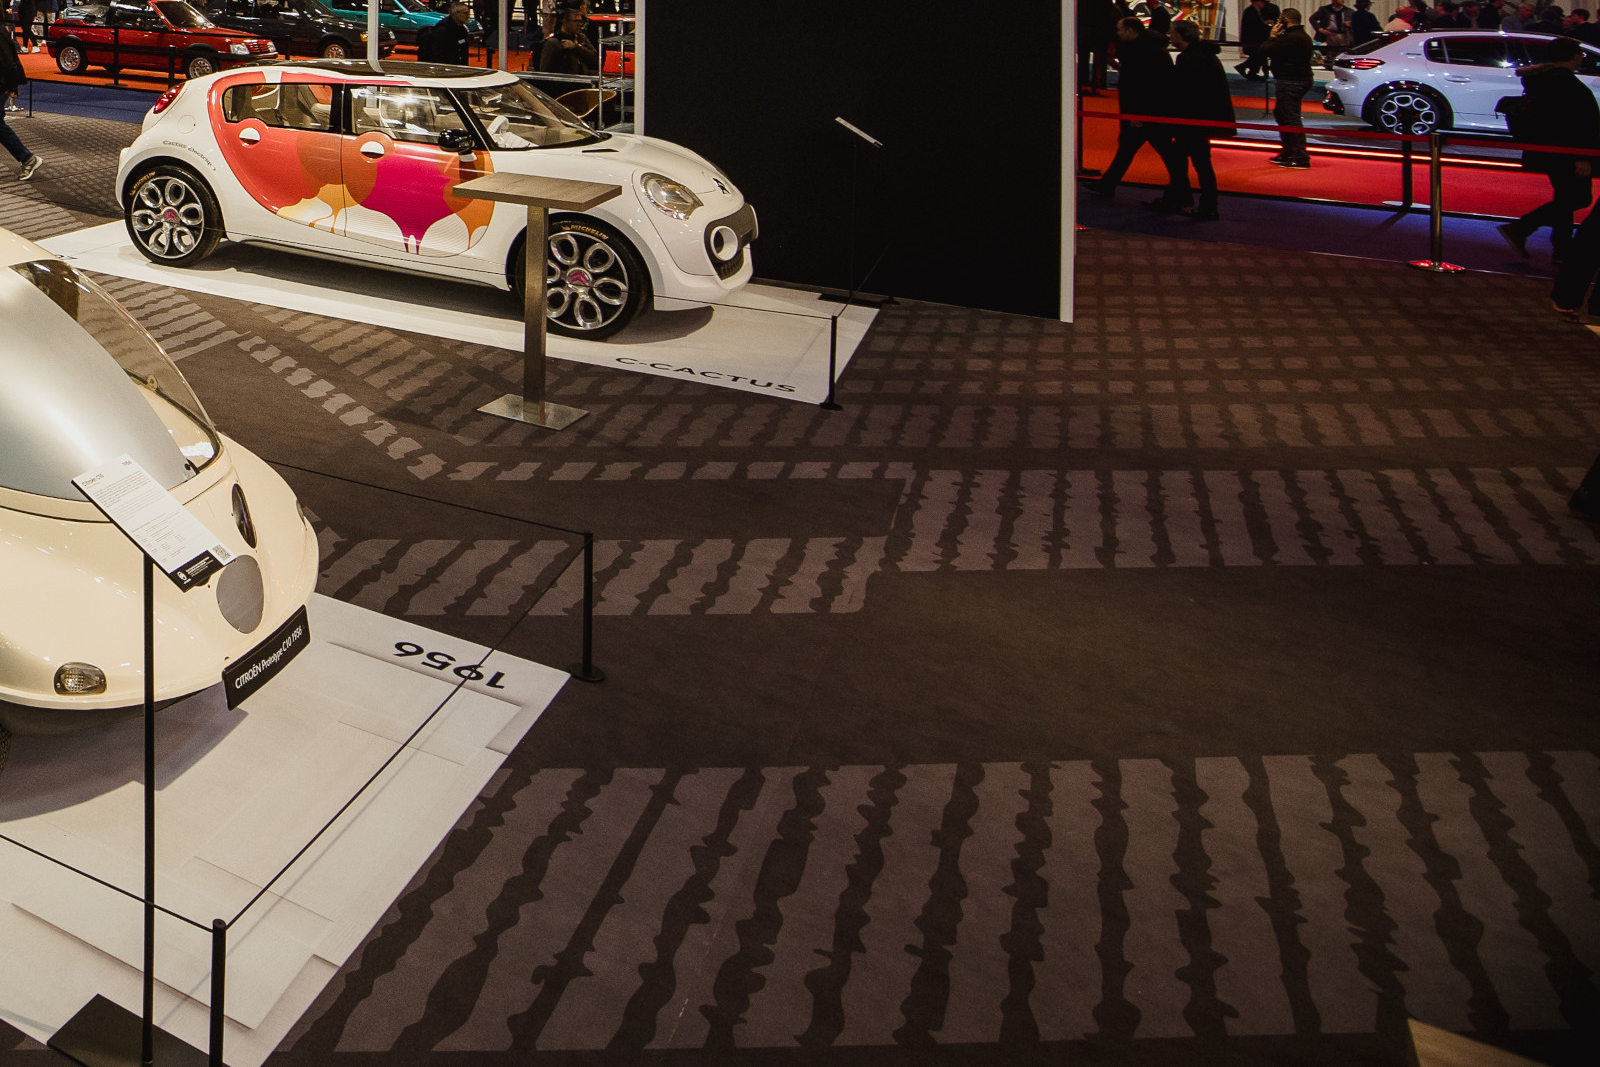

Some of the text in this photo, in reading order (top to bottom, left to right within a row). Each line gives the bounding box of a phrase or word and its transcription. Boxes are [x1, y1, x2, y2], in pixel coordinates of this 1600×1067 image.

[162, 140, 187, 149] Cactus
[570, 224, 609, 240] MICHELIN
[615, 357, 796, 392] C-CACTUS
[234, 625, 303, 689] CITROËN Prototype C10 1956
[393, 641, 505, 689] 1956
